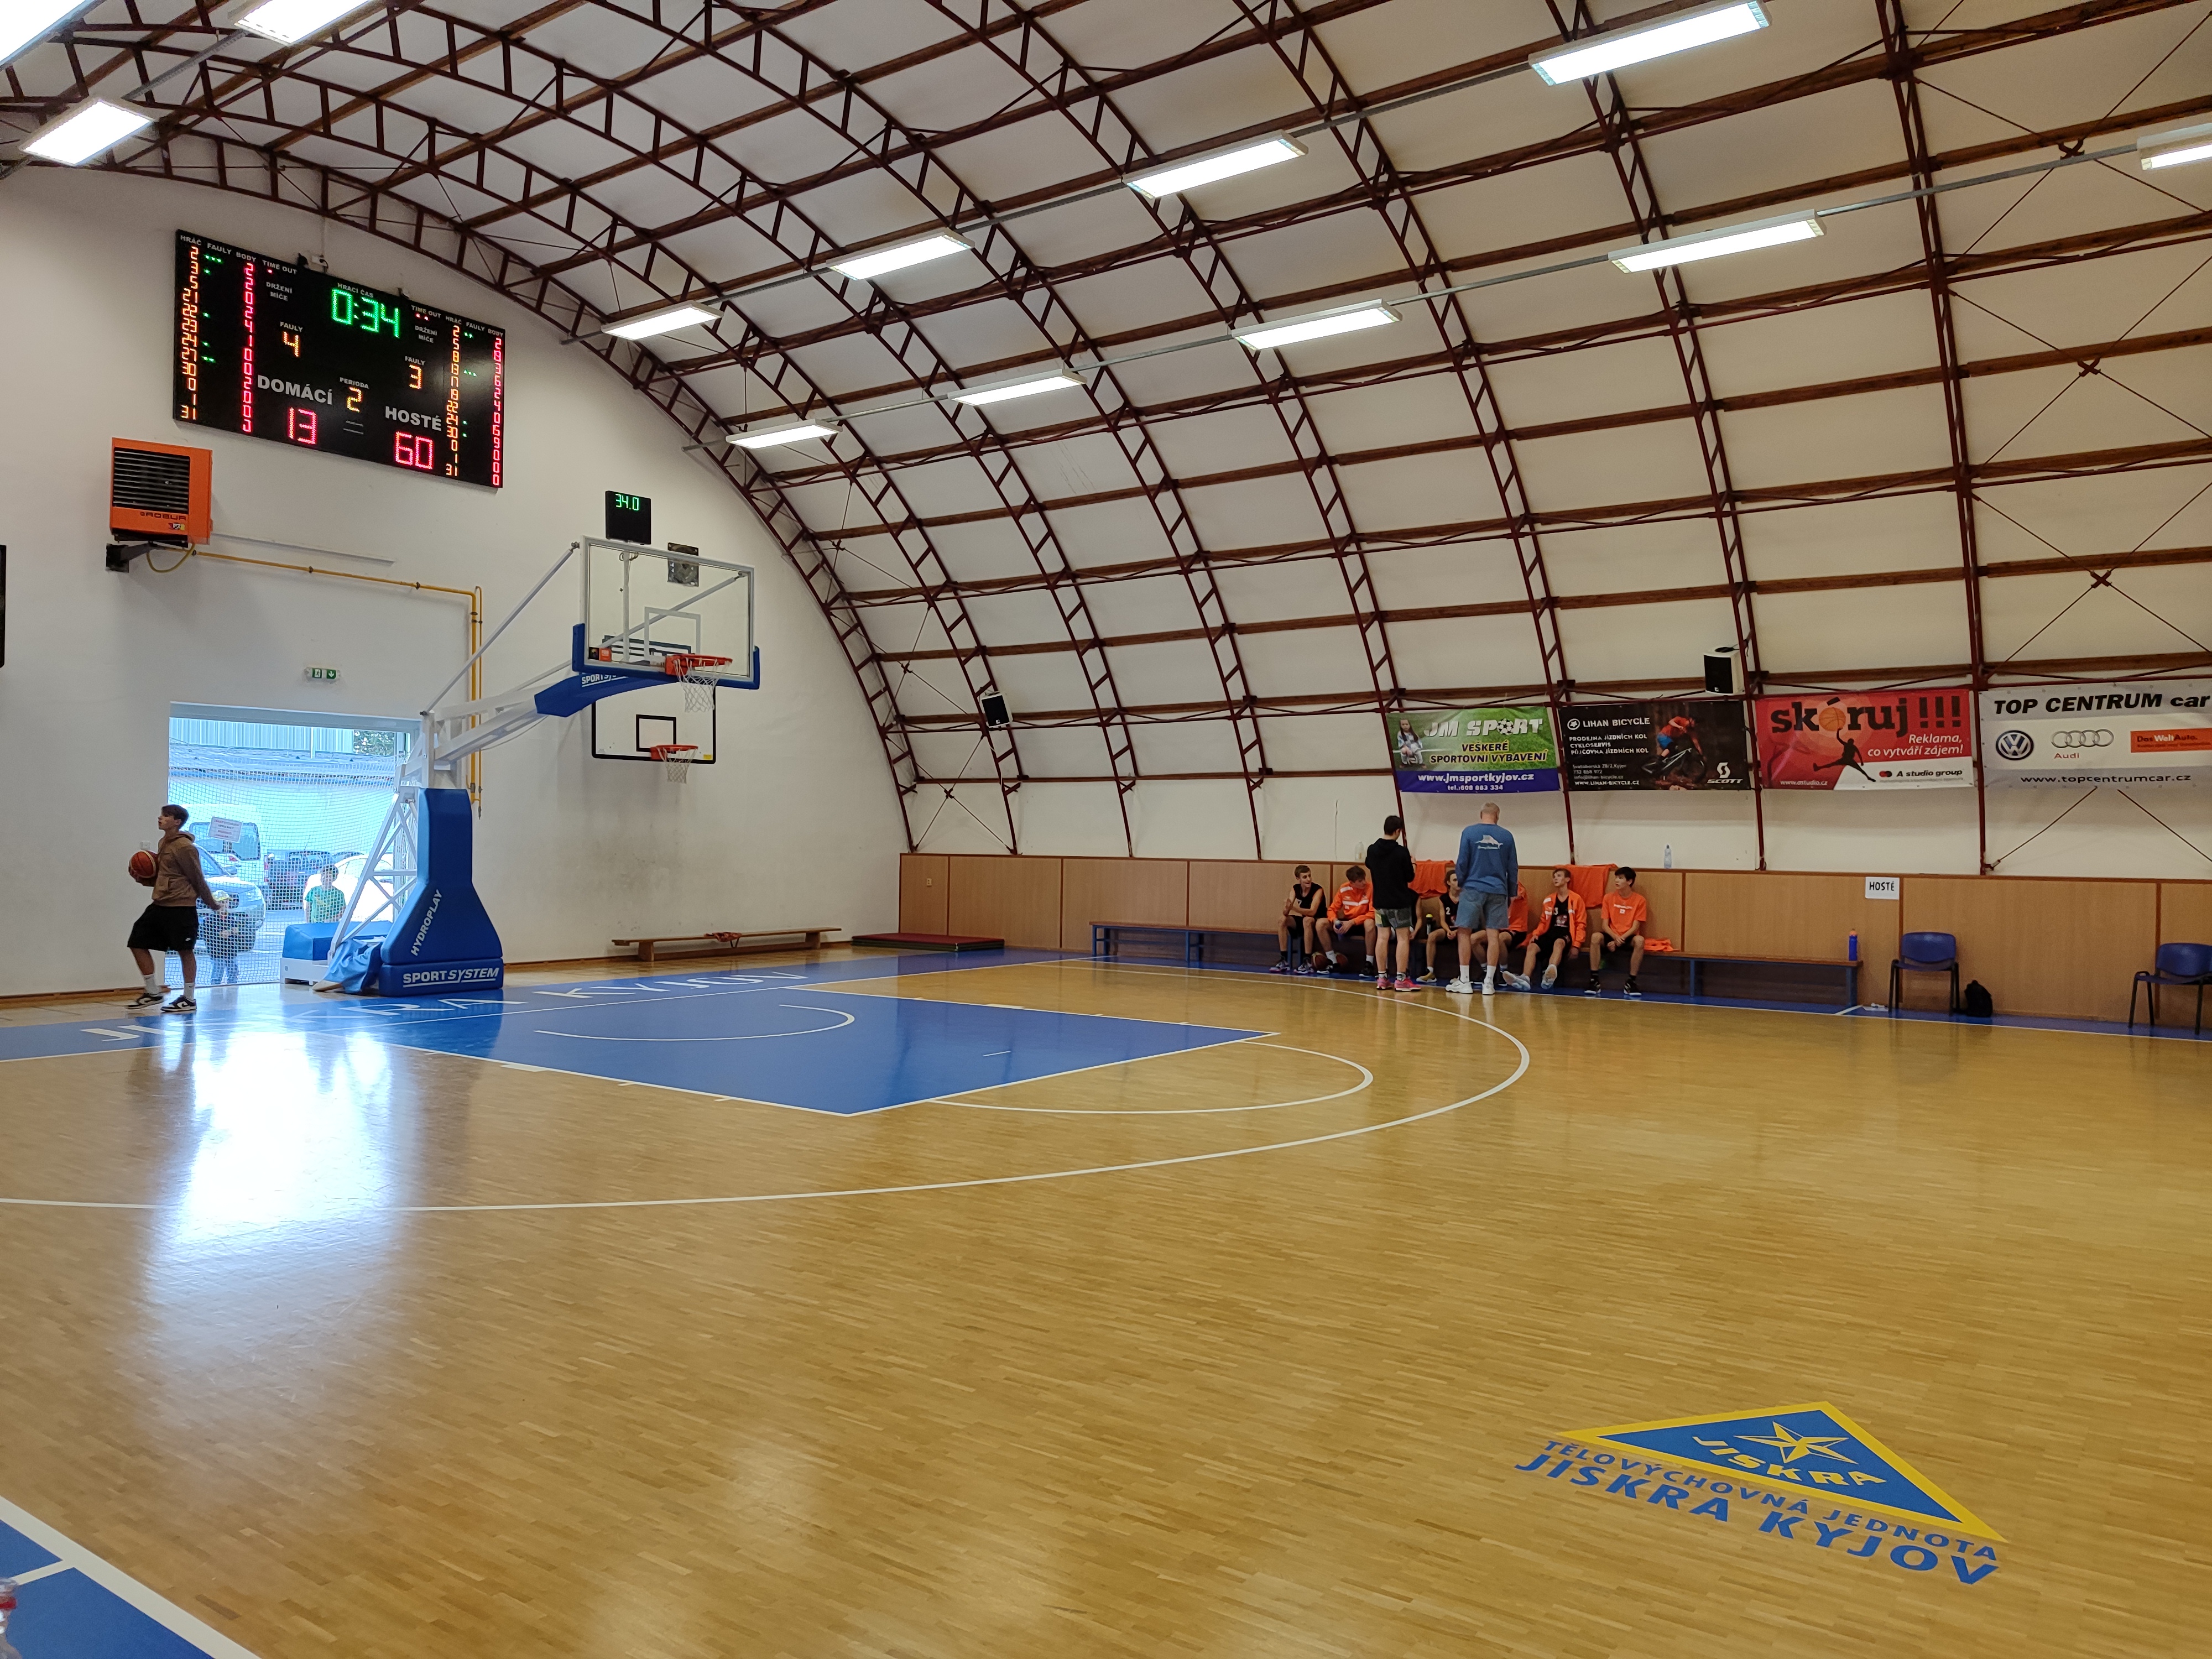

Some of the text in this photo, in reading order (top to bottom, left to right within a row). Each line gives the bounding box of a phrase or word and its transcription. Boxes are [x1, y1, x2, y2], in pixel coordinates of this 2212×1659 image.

[190, 246, 199, 260] 2
[207, 242, 232, 254] FAULY
[236, 252, 257, 262] BODY
[191, 261, 199, 274] 3
[246, 262, 254, 276] 2
[262, 260, 298, 275] TIME OUT
[190, 276, 198, 289] 5
[245, 277, 253, 290] 2
[245, 291, 253, 304] 0
[245, 306, 253, 319] 2
[332, 288, 399, 338] 0:34
[411, 305, 426, 314] TIME
[244, 320, 253, 333] 4
[280, 321, 303, 332] FAULY
[453, 325, 460, 337] 2
[466, 322, 485, 331] FAULY
[488, 328, 504, 337] BODY
[284, 331, 299, 357] 4
[453, 338, 460, 349] 5
[495, 337, 502, 349] 2
[244, 348, 252, 361] 0
[405, 356, 425, 366] FAULY
[453, 351, 460, 362] 8
[244, 362, 252, 375] 0
[243, 377, 252, 389] 2
[340, 377, 369, 389] PERIODA
[409, 364, 422, 389] 3
[188, 378, 196, 391] 0
[258, 375, 332, 405] DOMÁCÍ
[243, 390, 252, 403] 0
[347, 387, 362, 413] 2
[494, 388, 501, 399] 2
[243, 405, 252, 418] 0
[493, 400, 500, 411] 4
[181, 405, 196, 420] 31
[385, 406, 442, 431] HOSTÉ
[493, 411, 500, 424] 0
[288, 407, 317, 444] 13
[395, 431, 434, 469] 60
[451, 439, 458, 451] 0
[493, 449, 500, 461] 0
[446, 463, 457, 476] 31
[493, 462, 499, 473] 0
[493, 474, 499, 486] 0
[615, 493, 639, 511] 34.0
[1994, 693, 2211, 714] TOP CENTRUM car
[1423, 718, 1543, 737] JM SPORT
[1612, 717, 1651, 726] BICYCLE
[1908, 733, 1963, 744] Reklama,
[1462, 740, 1509, 752] VEŠKERÉ
[1867, 744, 1963, 758] co vytváří zájem!
[1431, 749, 1548, 763] SPORTOVNÍ VYBAVENÍ
[1418, 773, 1535, 784] www.jmsportkyjov.cz
[2020, 774, 2192, 785] www.topcentrumcar.cz
[1869, 881, 1895, 891] HOSTÉ
[1446, 906, 1451, 915] 2
[410, 889, 442, 956] HYDROPLAY
[1692, 1435, 1887, 1487] JISKRA
[1544, 1439, 1997, 1562] TĚLOVÝCHOVNÁ JEDNOTA
[1514, 1453, 2000, 1585] JISKRA KYJOV
